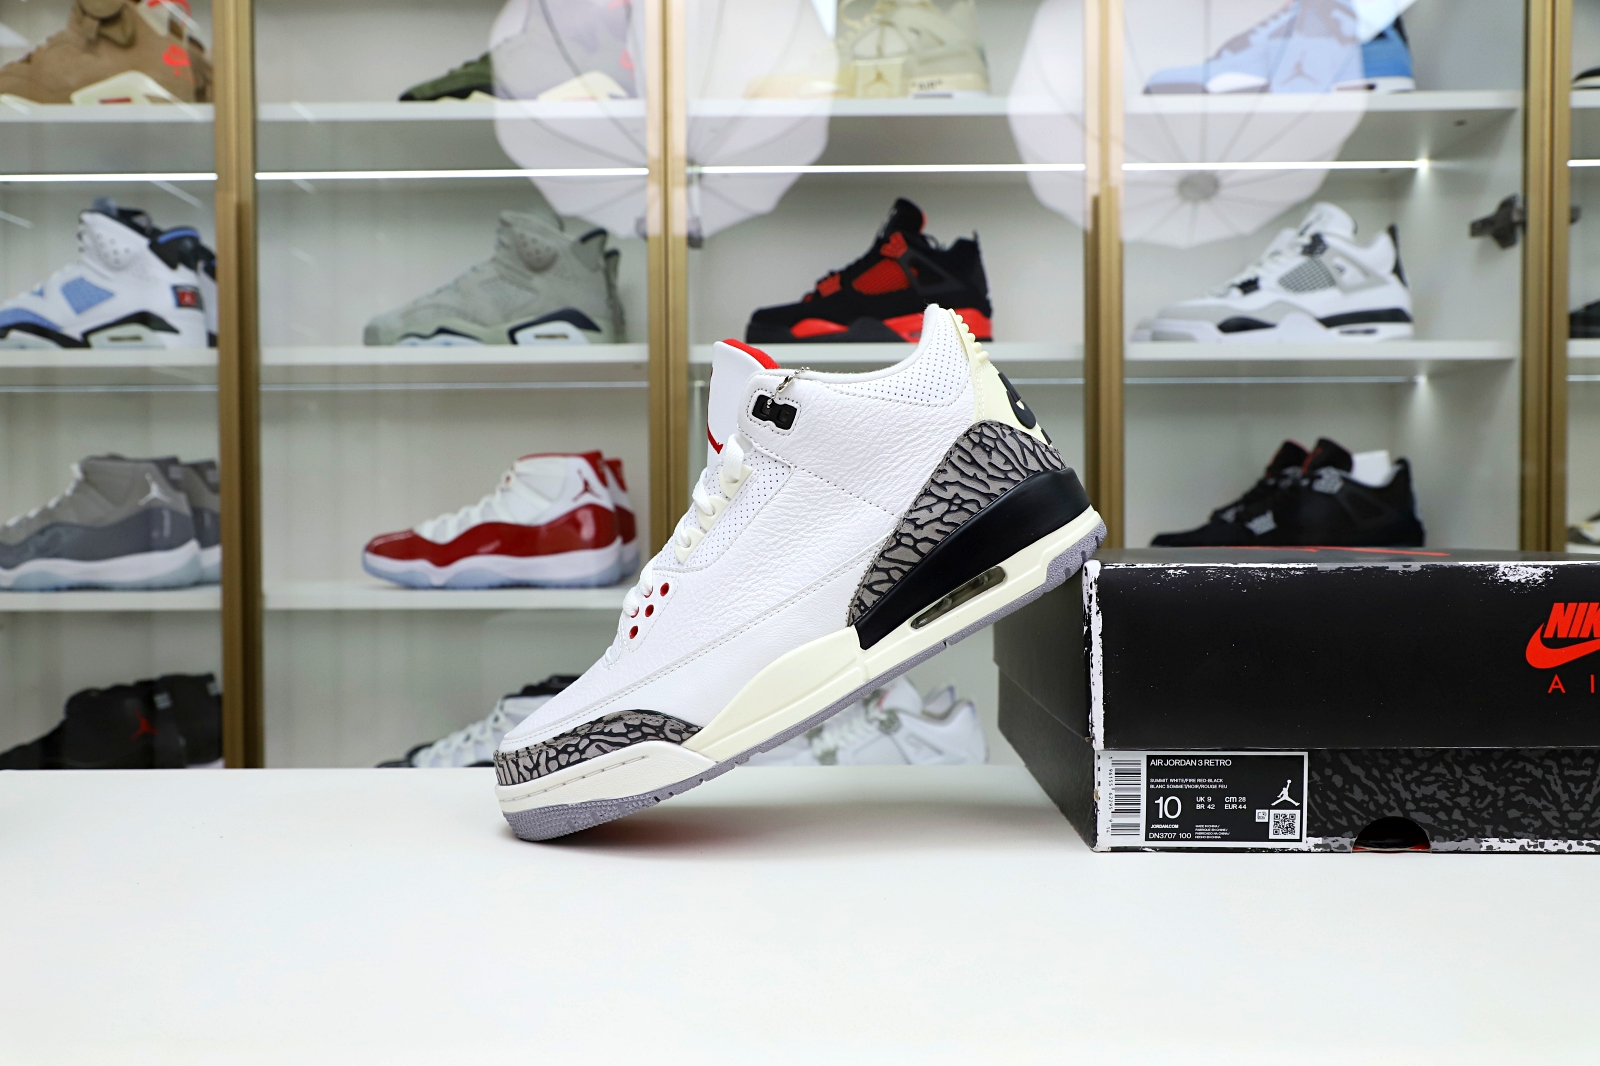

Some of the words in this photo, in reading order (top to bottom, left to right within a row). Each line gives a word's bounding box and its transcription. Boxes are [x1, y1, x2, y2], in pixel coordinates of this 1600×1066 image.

[1543, 602, 1600, 638] NIK
[1547, 674, 1596, 694] AI
[1149, 759, 1164, 767] AIR
[1163, 759, 1197, 767] JORDAN
[1197, 759, 1204, 767] 3
[1204, 759, 1232, 767] RETRO
[1154, 796, 1182, 819] 10
